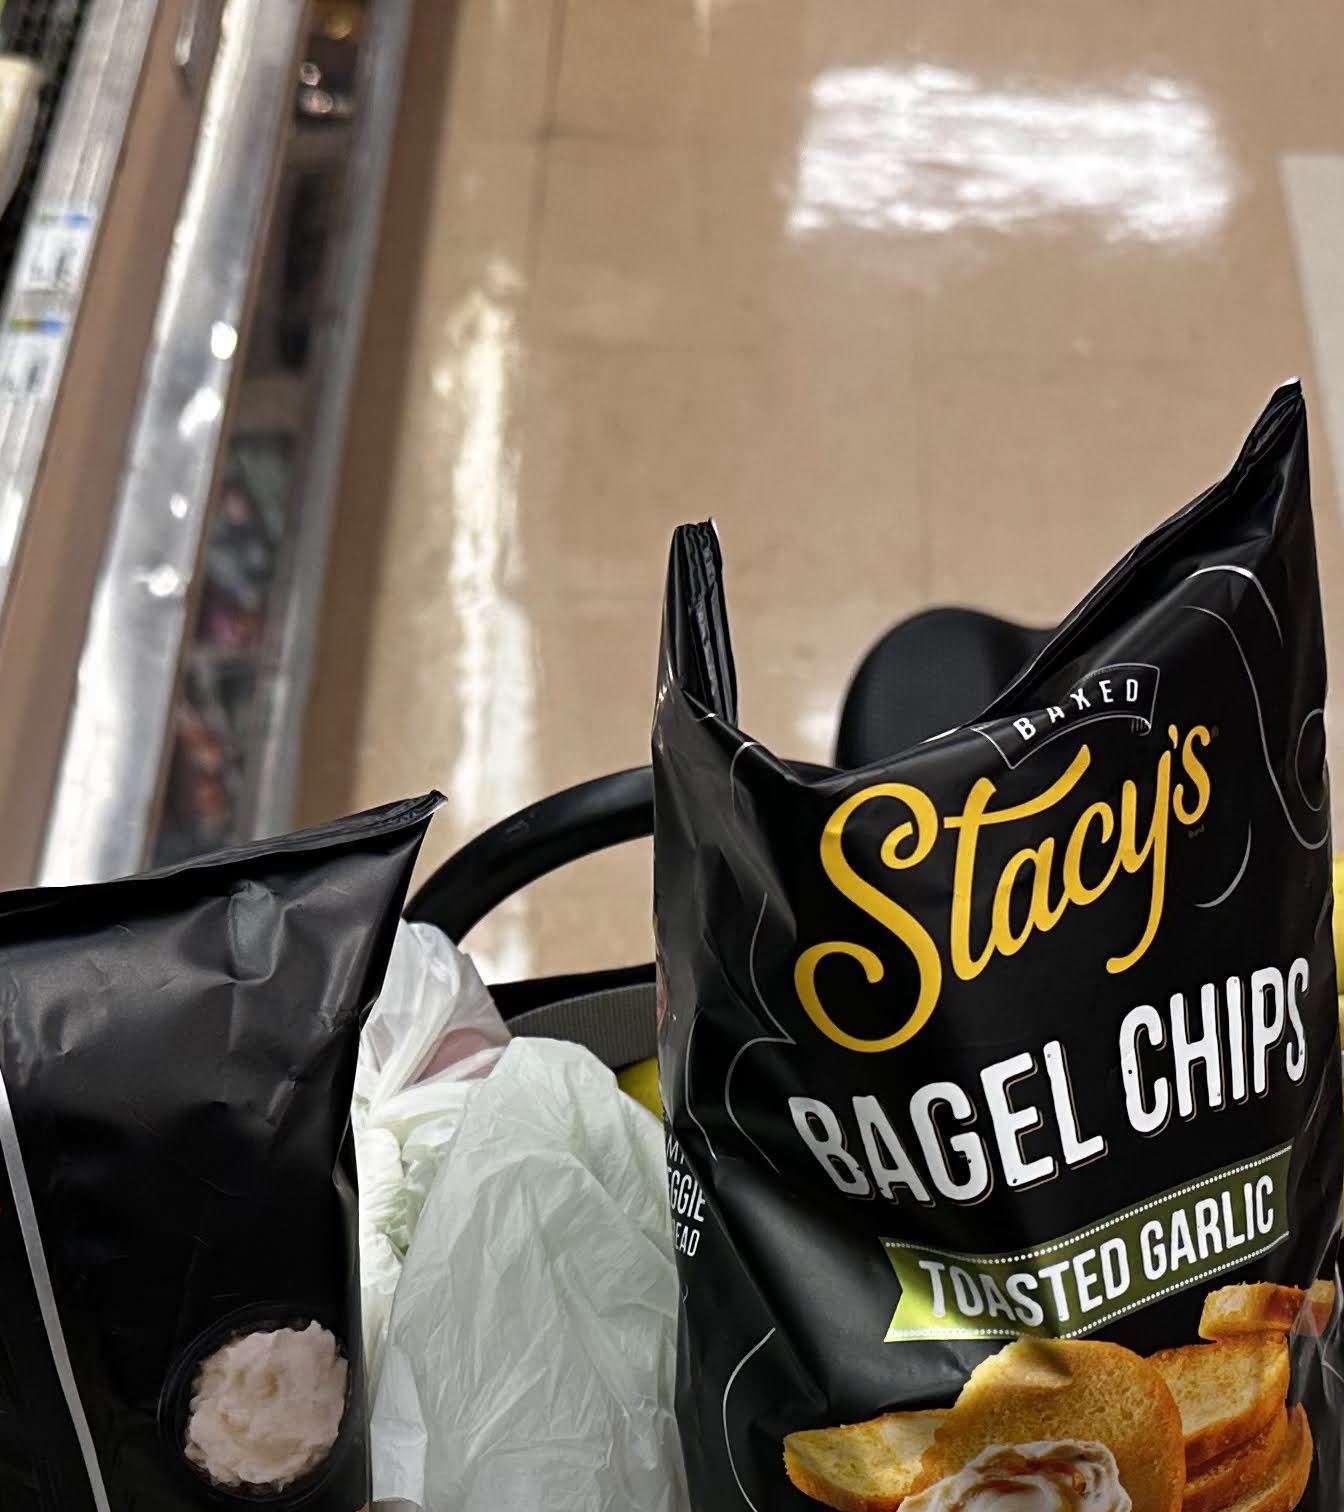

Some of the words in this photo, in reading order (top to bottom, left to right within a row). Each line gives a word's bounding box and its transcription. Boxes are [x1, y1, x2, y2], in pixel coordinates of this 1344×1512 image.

[1012, 677, 1140, 741] BAKED
[794, 723, 1213, 1053] Stacy's
[788, 1039, 1108, 1204] BAGEL
[1118, 957, 1311, 1136] CHIPS
[918, 1237, 1132, 1330] TOASTED
[1144, 1174, 1277, 1276] GARLIC
